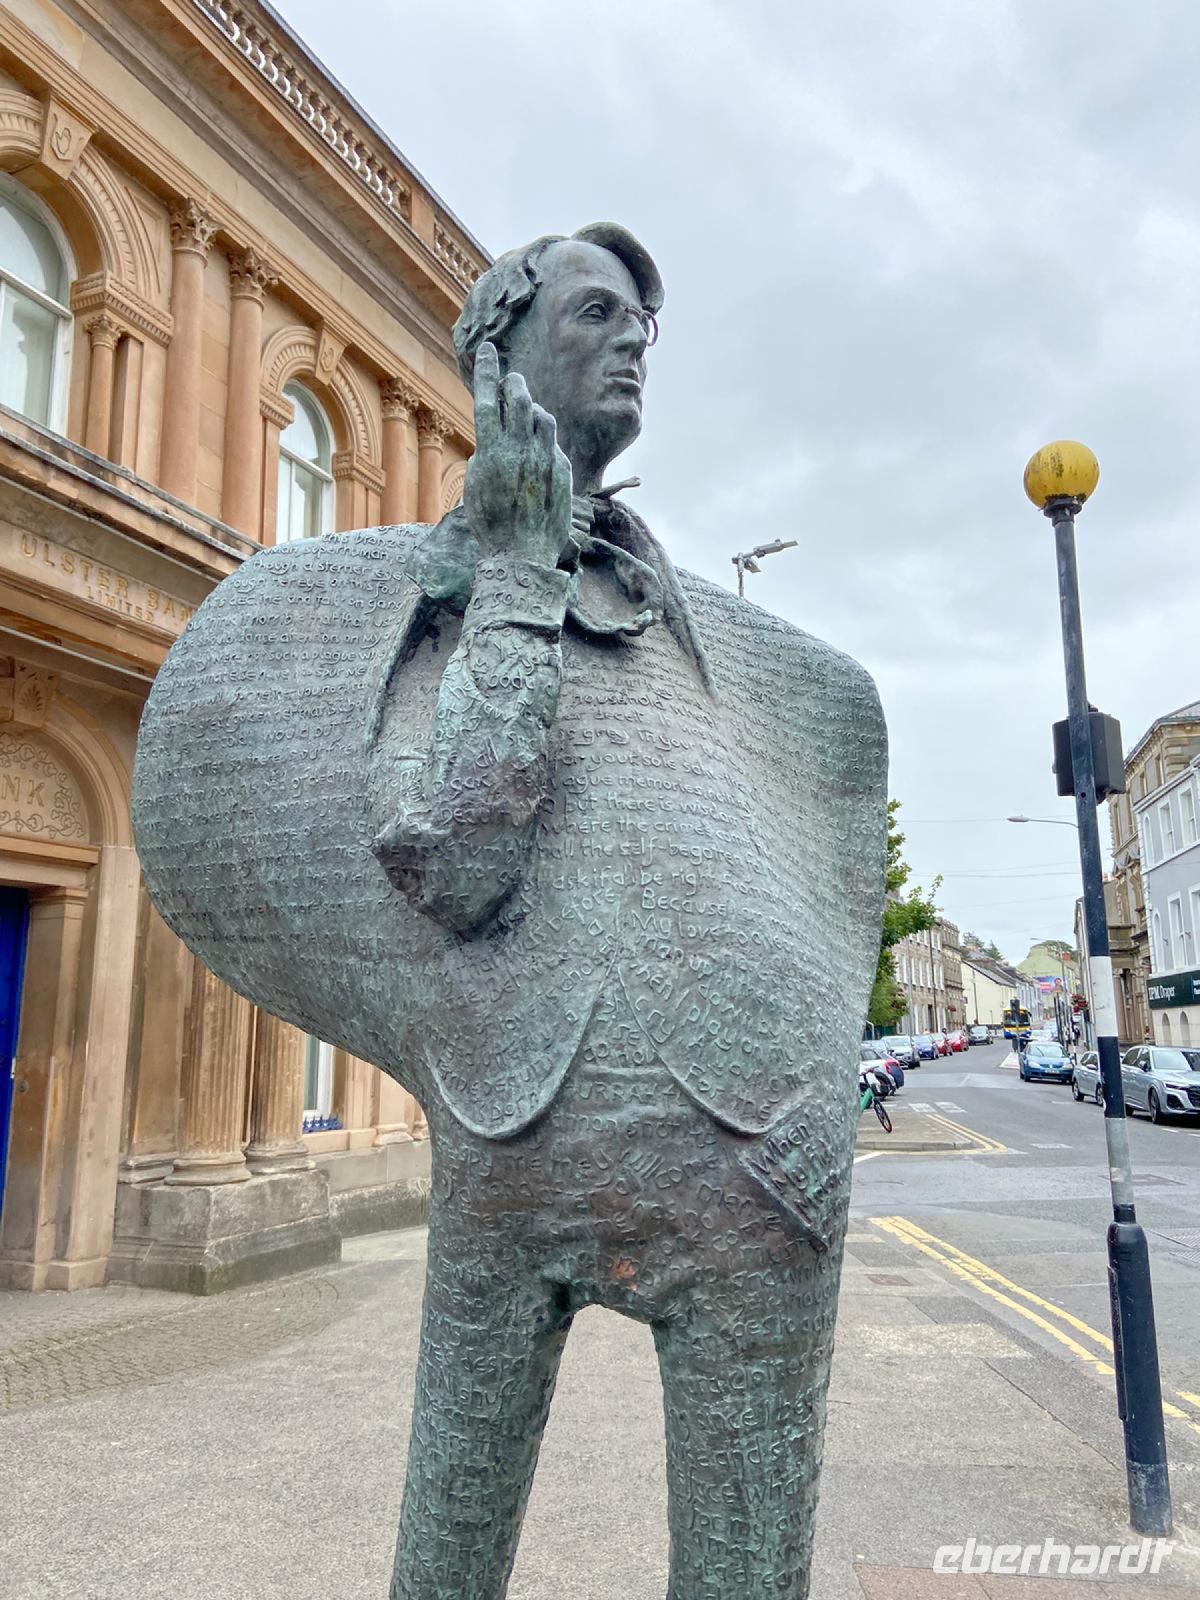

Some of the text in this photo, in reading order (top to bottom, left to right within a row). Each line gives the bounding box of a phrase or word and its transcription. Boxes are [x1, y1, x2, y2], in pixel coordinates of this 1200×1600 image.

[21, 534, 129, 599] ULSTER
[86, 586, 155, 624] LIMITED
[641, 886, 728, 916] Because
